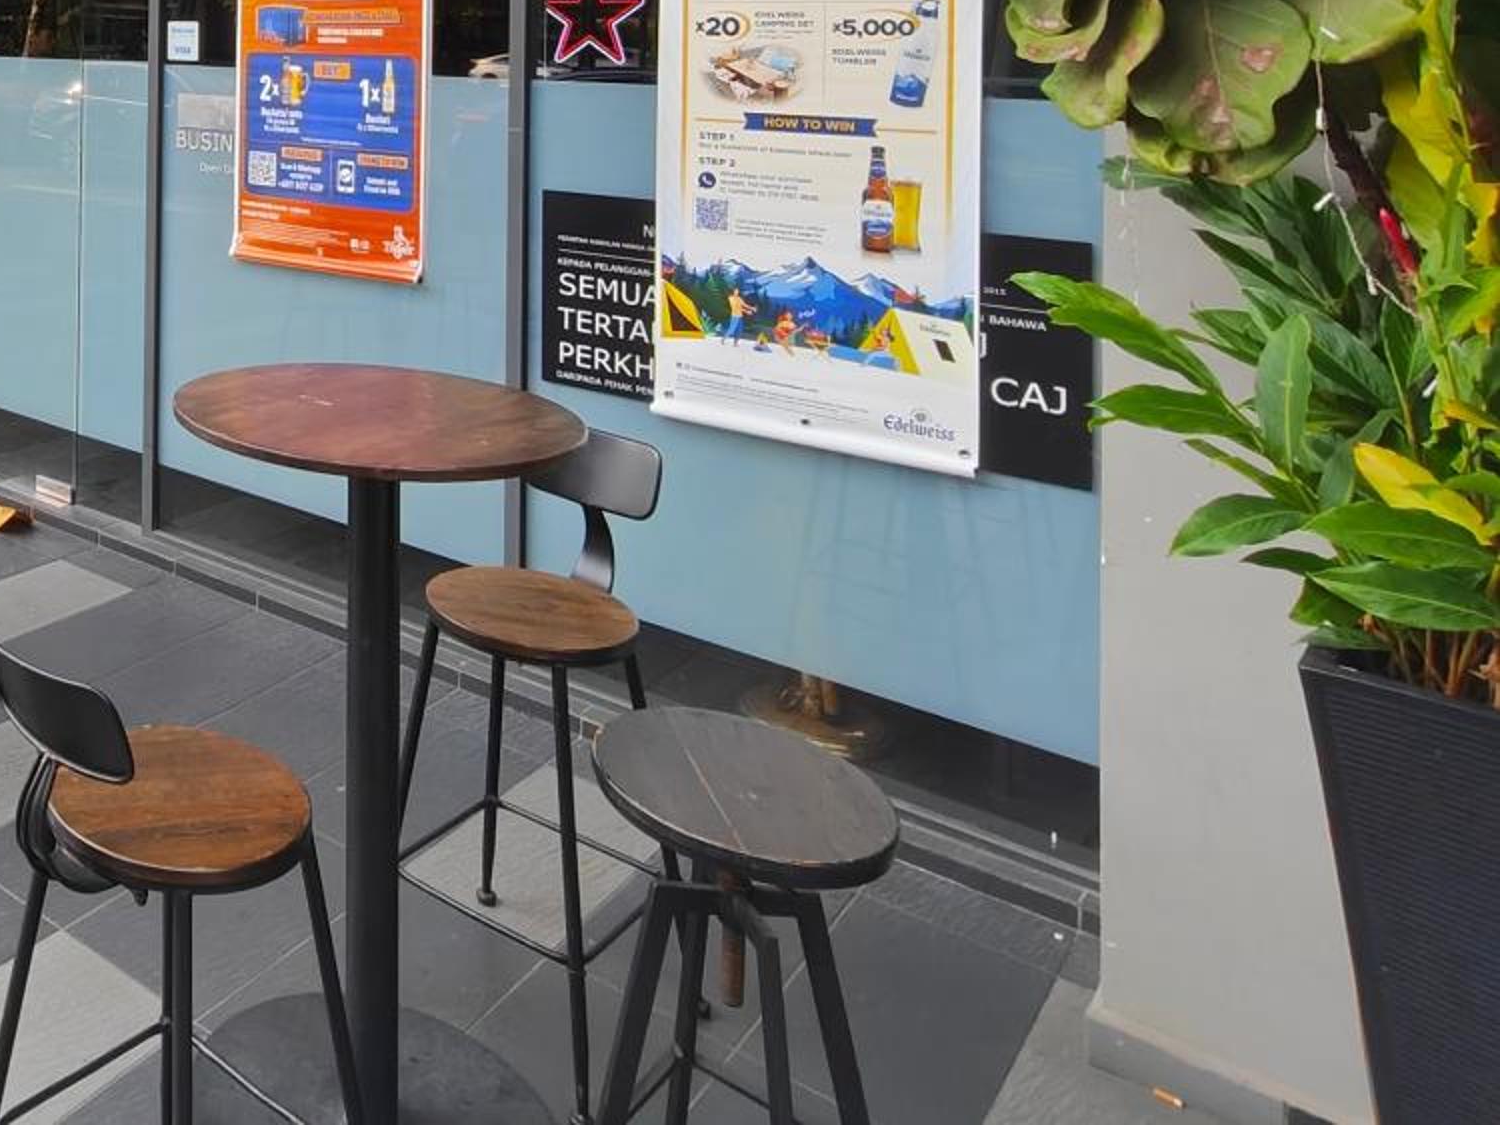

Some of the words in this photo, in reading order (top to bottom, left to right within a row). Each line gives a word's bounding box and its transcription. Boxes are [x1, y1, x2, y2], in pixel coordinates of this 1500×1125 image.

[695, 16, 742, 37] x20
[831, 18, 916, 39] x5,000
[763, 117, 798, 129] HOW
[803, 119, 822, 131] TO
[825, 120, 856, 133] WIN
[174, 129, 234, 154] BUSIN
[698, 132, 728, 142] STEP
[698, 157, 727, 167] STEP
[557, 257, 593, 270] KEPADA
[558, 272, 656, 308] SEMUA
[557, 305, 651, 344] TERTA
[988, 314, 1048, 332] BAHAWA
[558, 340, 654, 381] PERKH
[990, 376, 1068, 416] CAJ
[883, 413, 955, 442] Edelweiss
